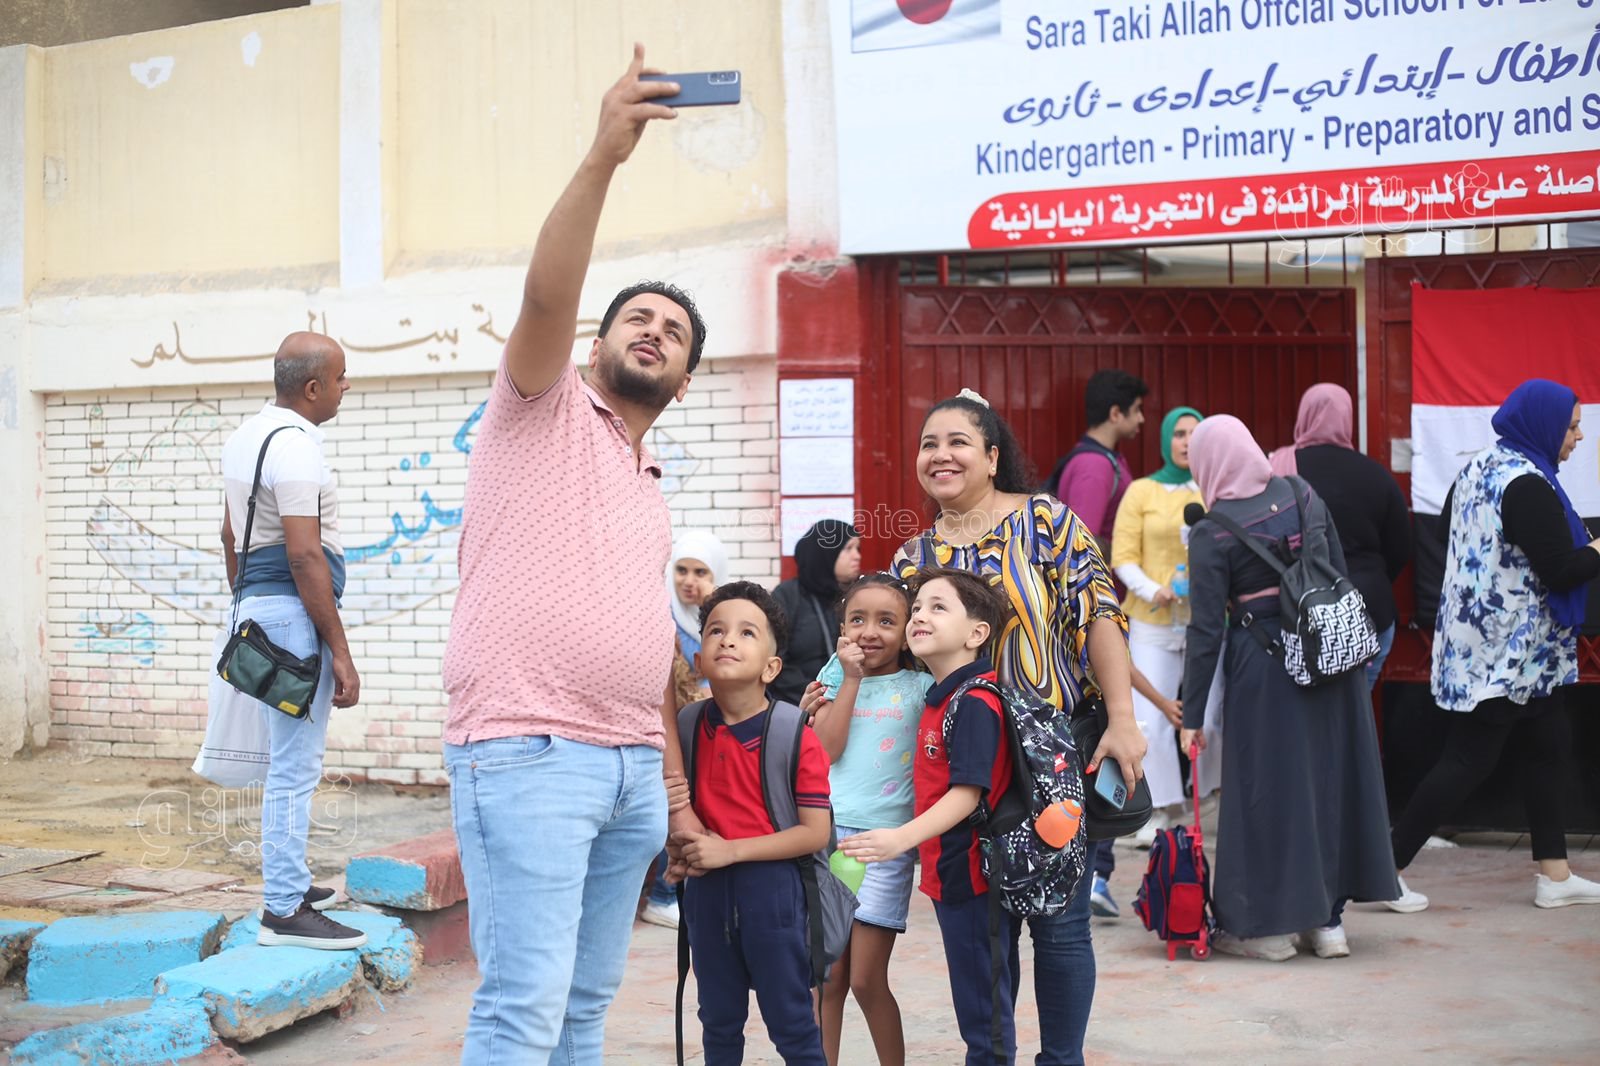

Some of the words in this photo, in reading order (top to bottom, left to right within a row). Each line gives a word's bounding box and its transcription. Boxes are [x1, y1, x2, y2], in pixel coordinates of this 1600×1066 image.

[1026, 15, 1086, 50] Sara
[1094, 5, 1151, 43] Taki
[1161, 0, 1231, 38] Allah
[1344, 0, 1447, 20] Scoo
[976, 135, 1155, 178] Kindergarten
[1183, 125, 1295, 162] Primary
[1324, 108, 1504, 155] Preparatory
[1514, 96, 1572, 136] and
[1109, 192, 1215, 234] التجربة
[1365, 173, 1465, 214] المدرسة
[988, 199, 1105, 241] اليابانية
